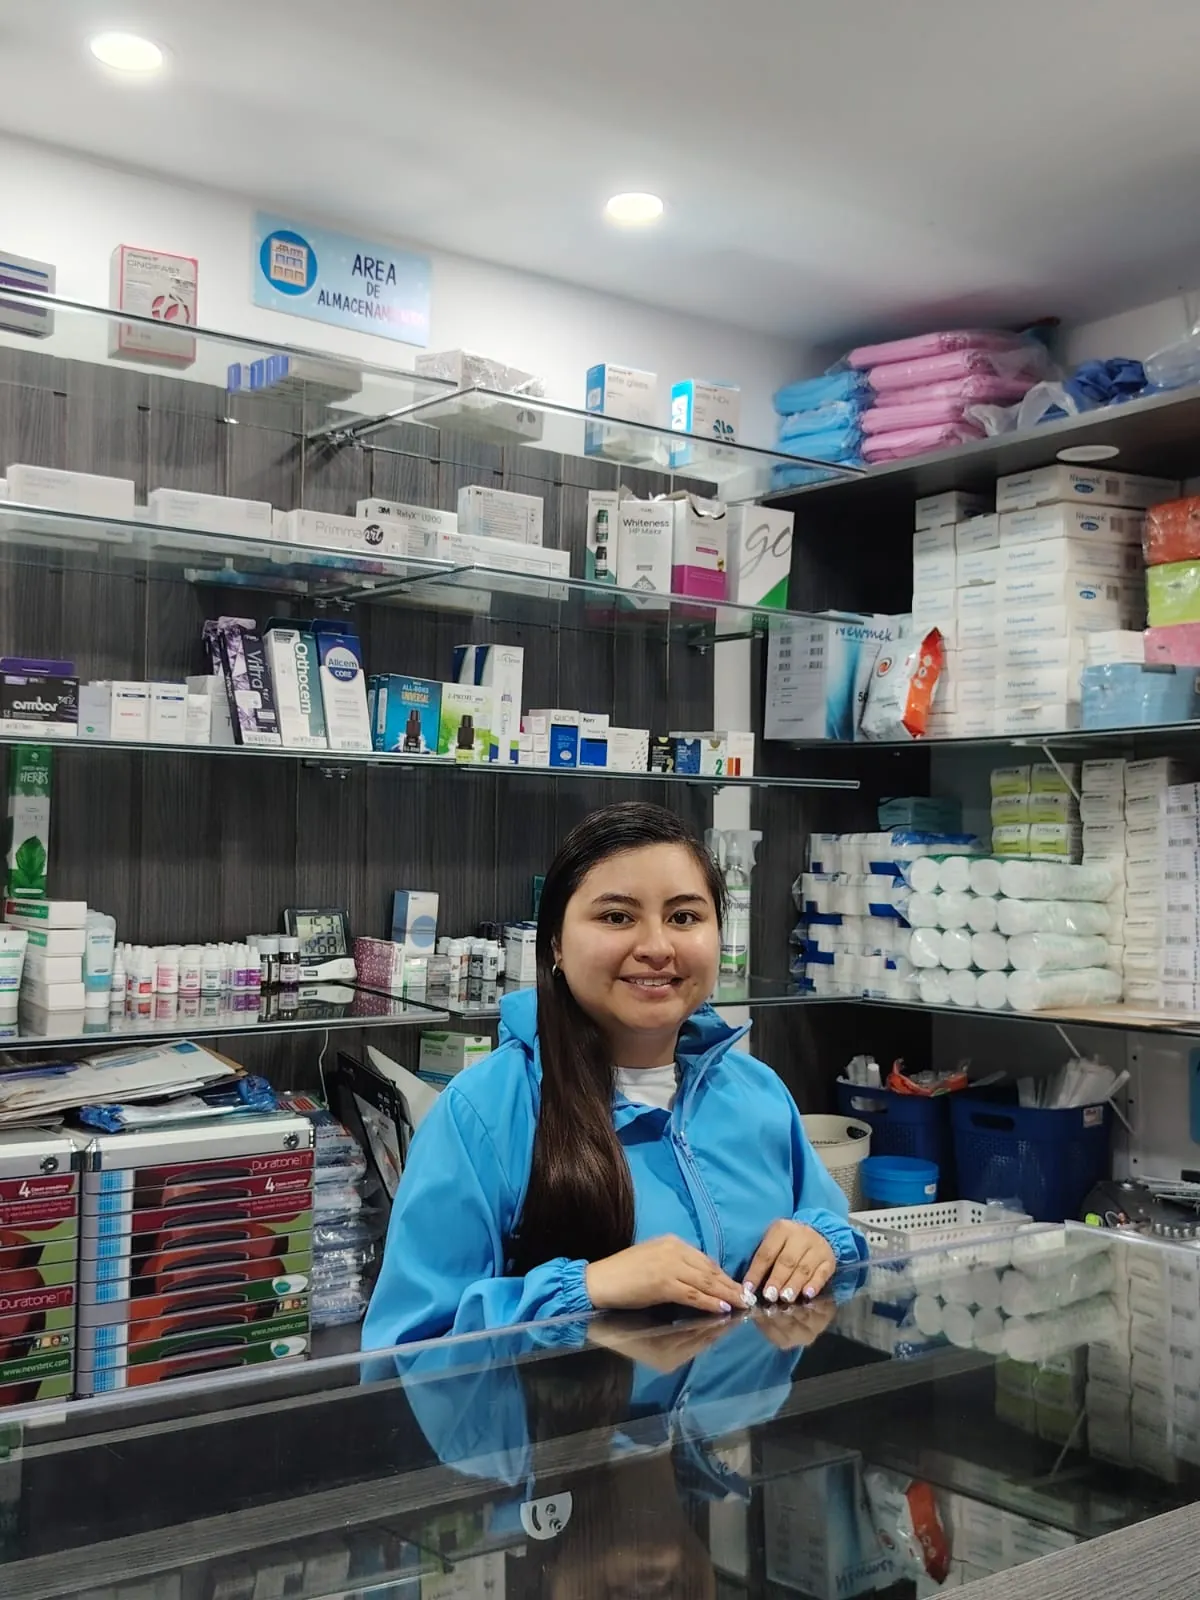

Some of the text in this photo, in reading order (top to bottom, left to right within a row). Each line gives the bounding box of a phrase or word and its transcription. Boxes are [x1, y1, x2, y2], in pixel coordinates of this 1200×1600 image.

[351, 253, 397, 286] AREA
[366, 281, 381, 299] DE
[622, 519, 670, 528] Whiteness
[294, 641, 312, 715] Orthocem
[20, 771, 49, 785] HERBS
[18, 1181, 31, 1198] 4
[265, 1176, 275, 1193] 4
